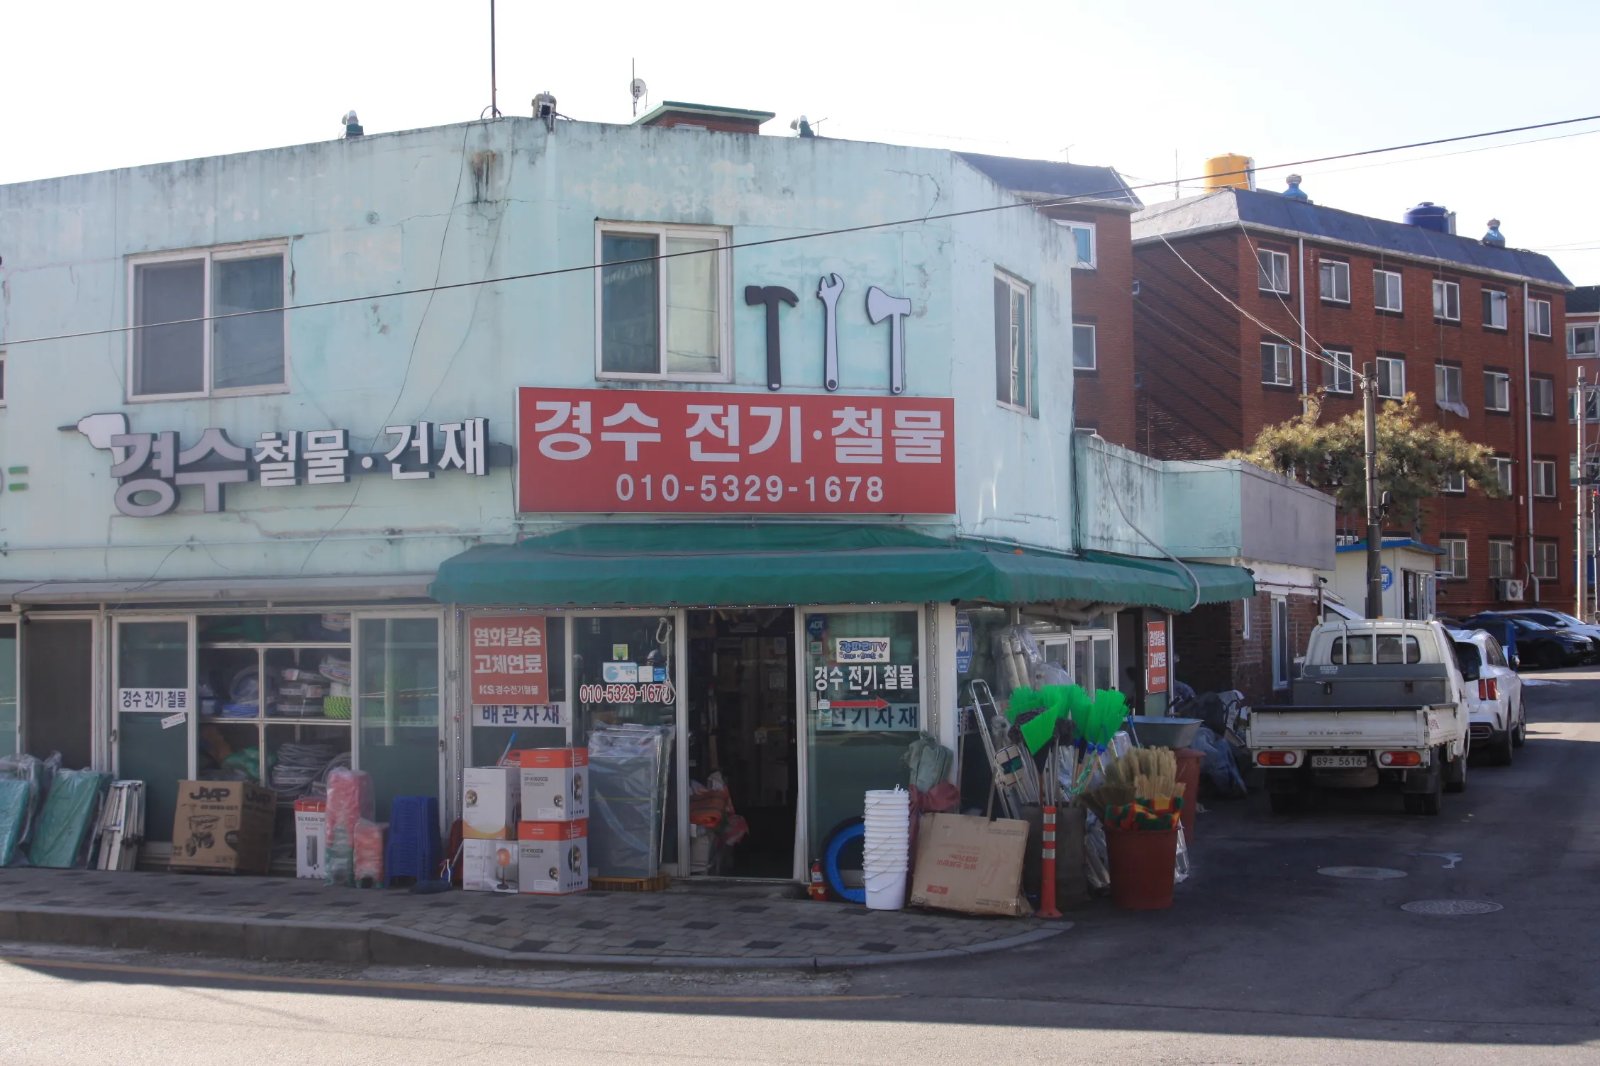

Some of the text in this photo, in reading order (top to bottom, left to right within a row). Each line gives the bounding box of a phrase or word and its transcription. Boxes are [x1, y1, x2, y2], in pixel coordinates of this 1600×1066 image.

[535, 401, 662, 462] 경수
[110, 428, 249, 518] 경수
[616, 474, 884, 503] 010-5329-1678
[474, 627, 541, 647] 염화칼슘
[474, 654, 543, 674] 고체연료
[814, 665, 843, 691] 경수
[123, 690, 142, 708] 경수
